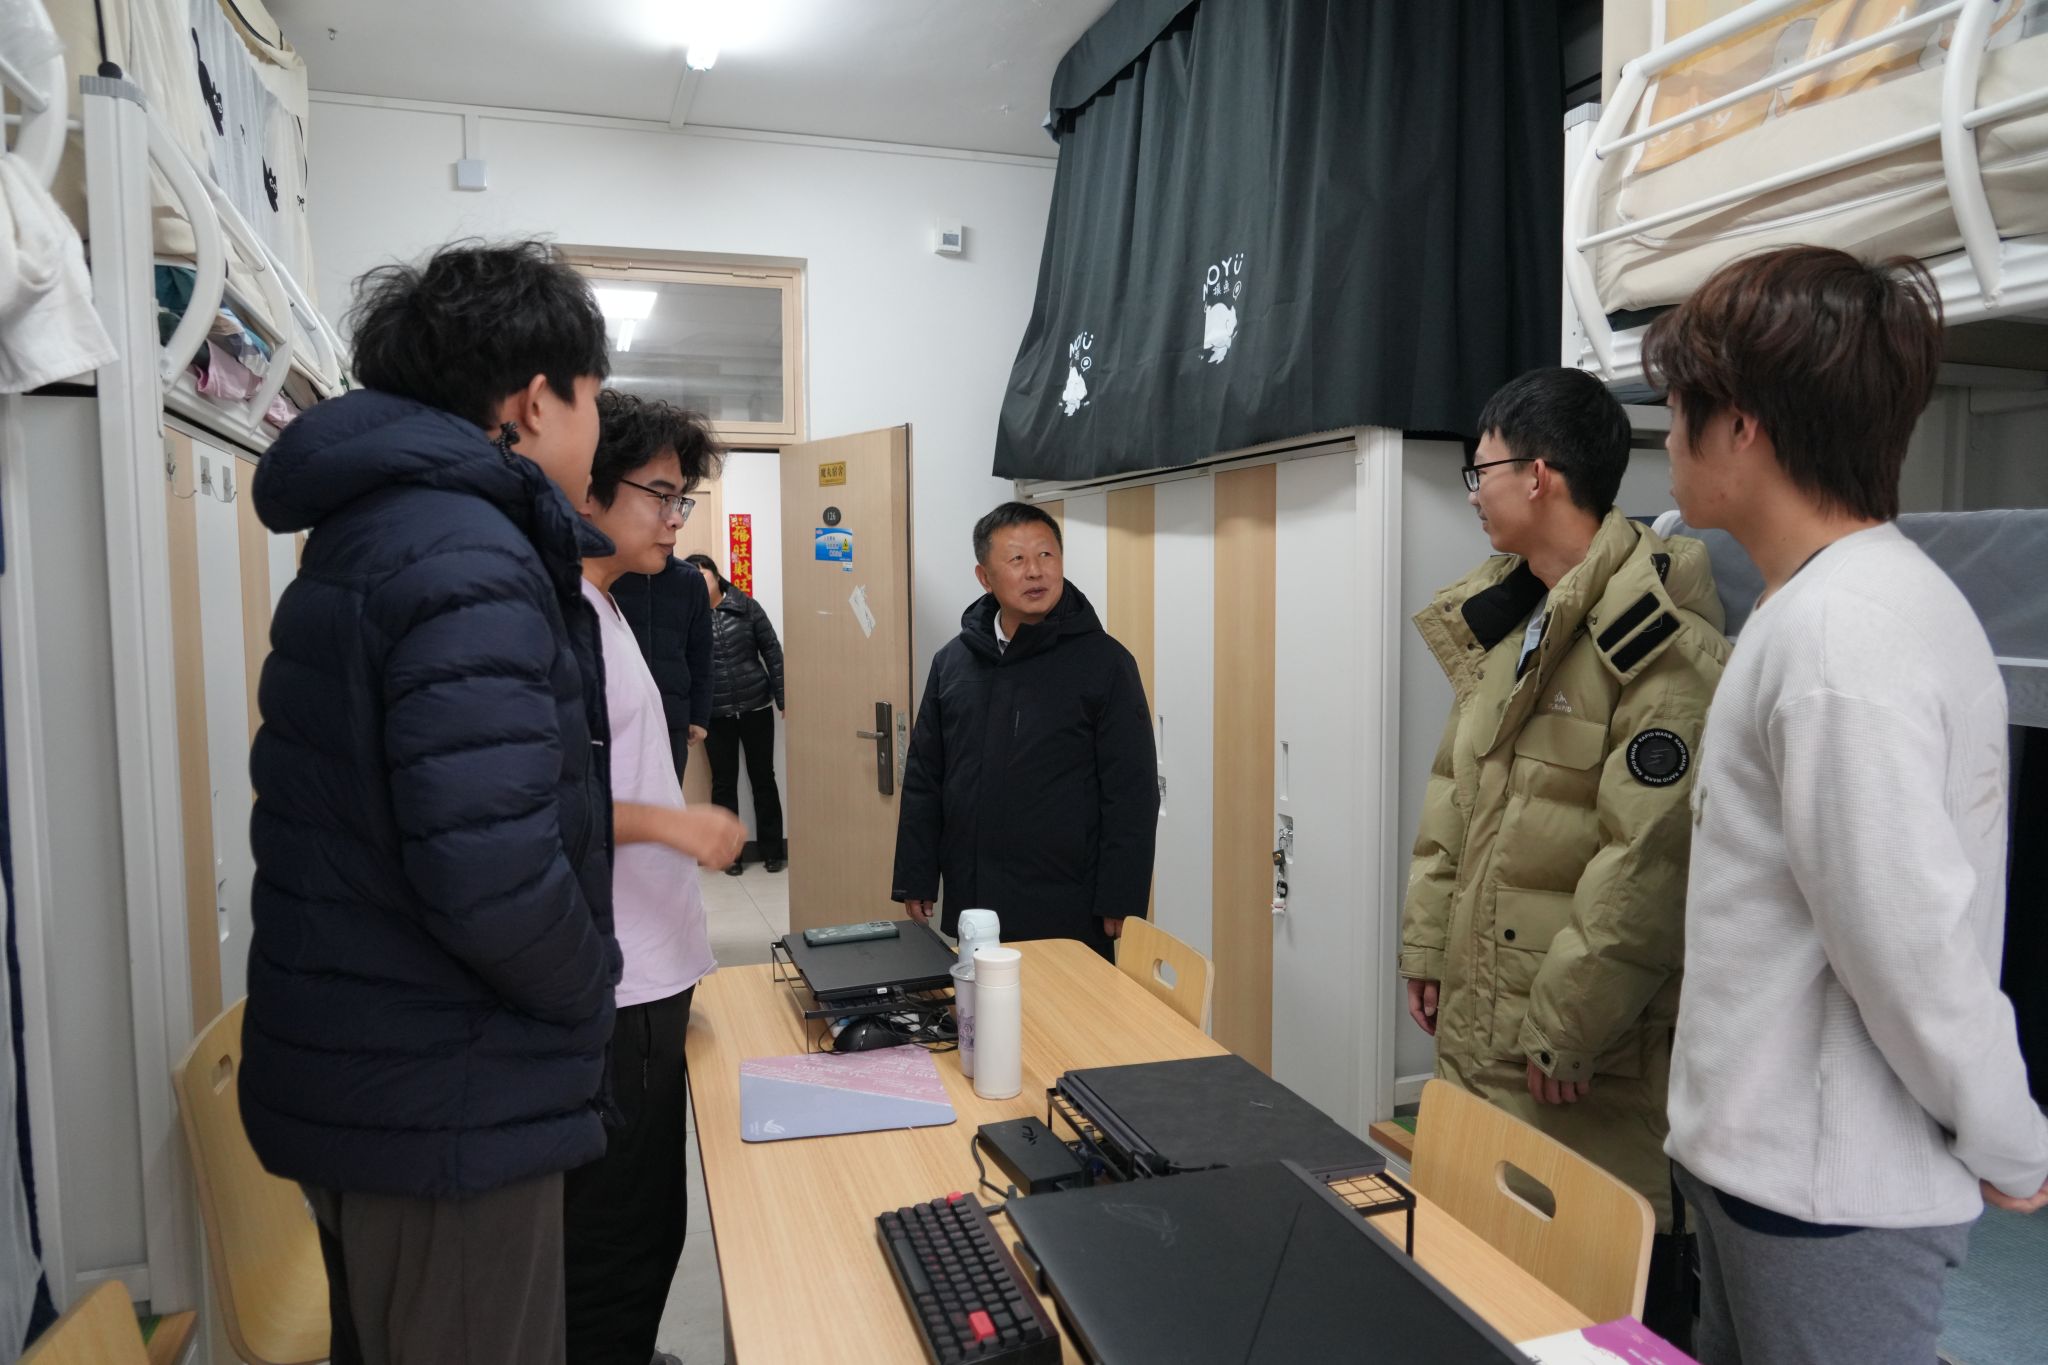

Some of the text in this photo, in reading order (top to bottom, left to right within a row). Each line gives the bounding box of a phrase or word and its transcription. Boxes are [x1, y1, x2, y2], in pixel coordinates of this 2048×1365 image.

[827, 511, 837, 521] 126
[1654, 731, 1673, 739] WARM
[1630, 743, 1639, 759] WARM
